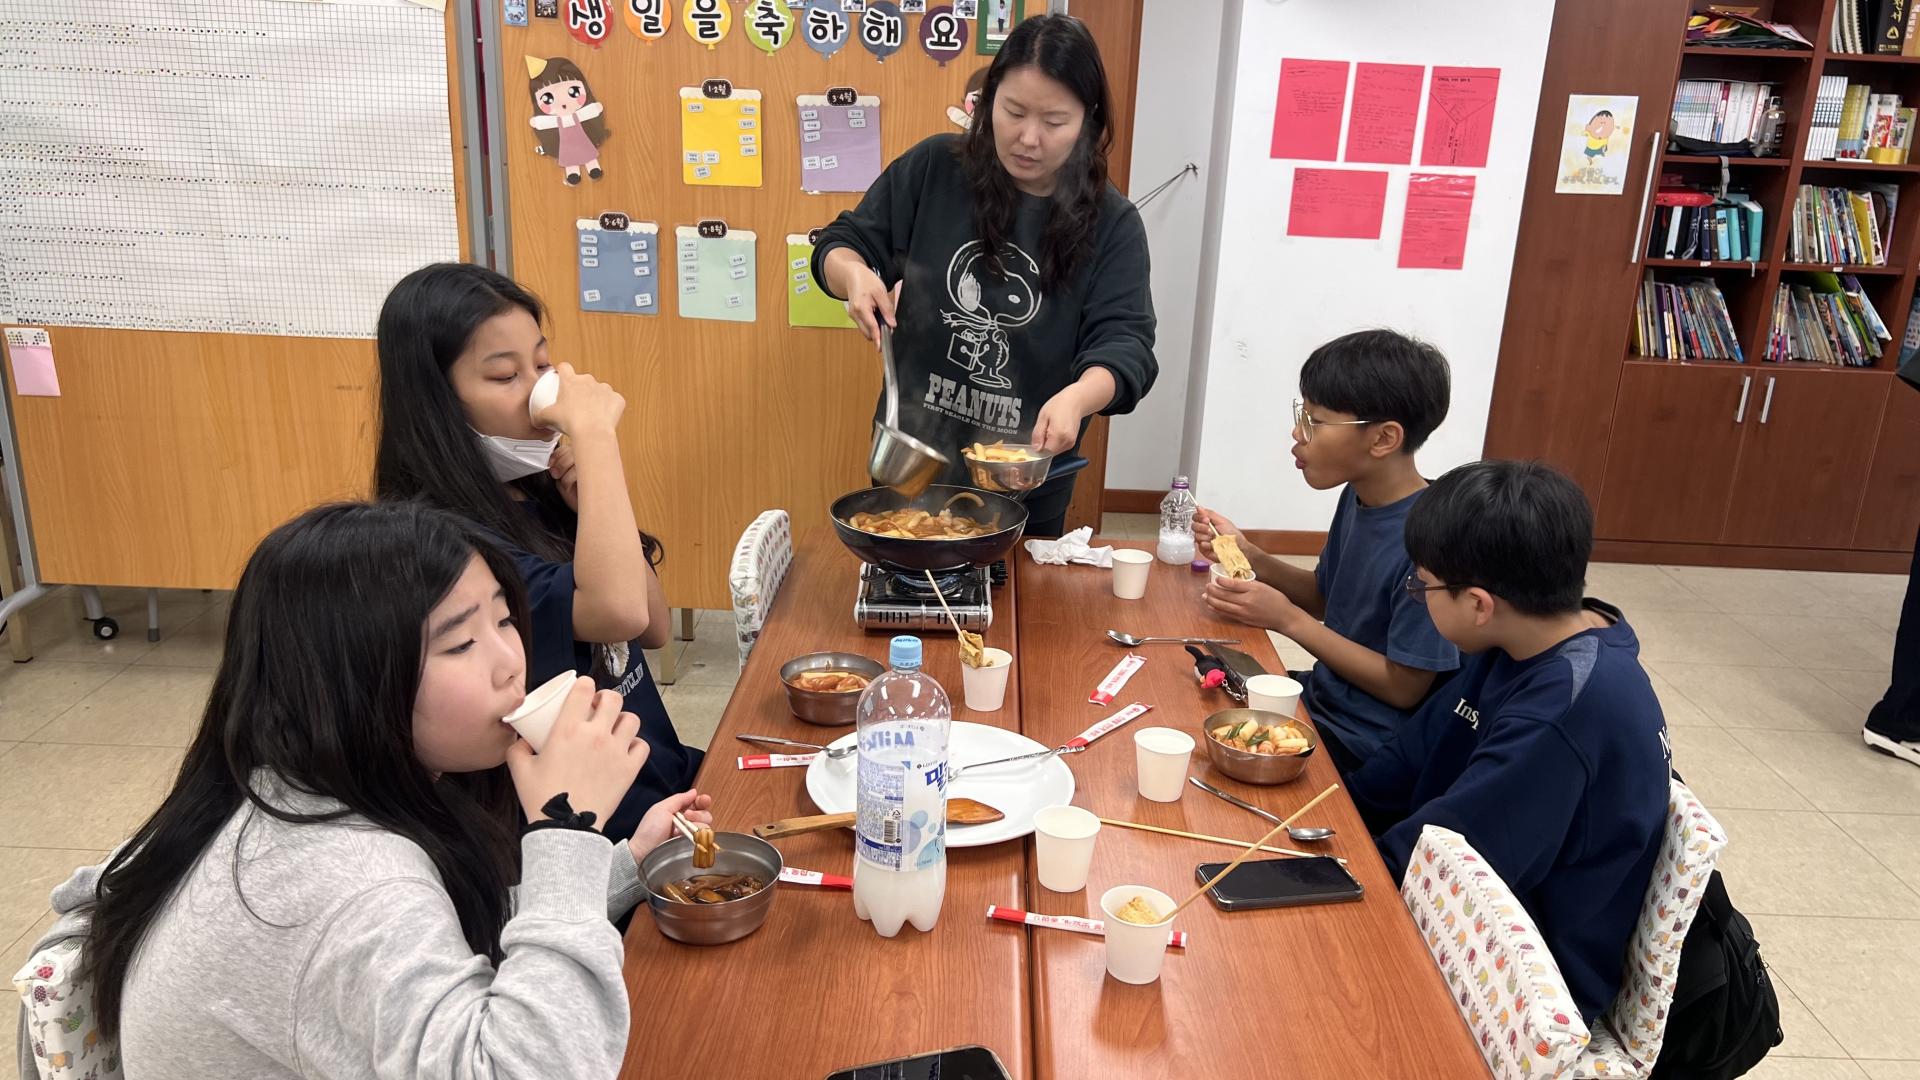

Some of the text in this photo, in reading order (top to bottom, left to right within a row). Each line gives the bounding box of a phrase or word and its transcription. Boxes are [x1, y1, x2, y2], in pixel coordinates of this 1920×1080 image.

[923, 402, 944, 413] FIRST
[971, 419, 981, 428] ON
[982, 424, 996, 432] THE
[997, 427, 1018, 435] MOON
[924, 372, 1022, 429] PEANUTS
